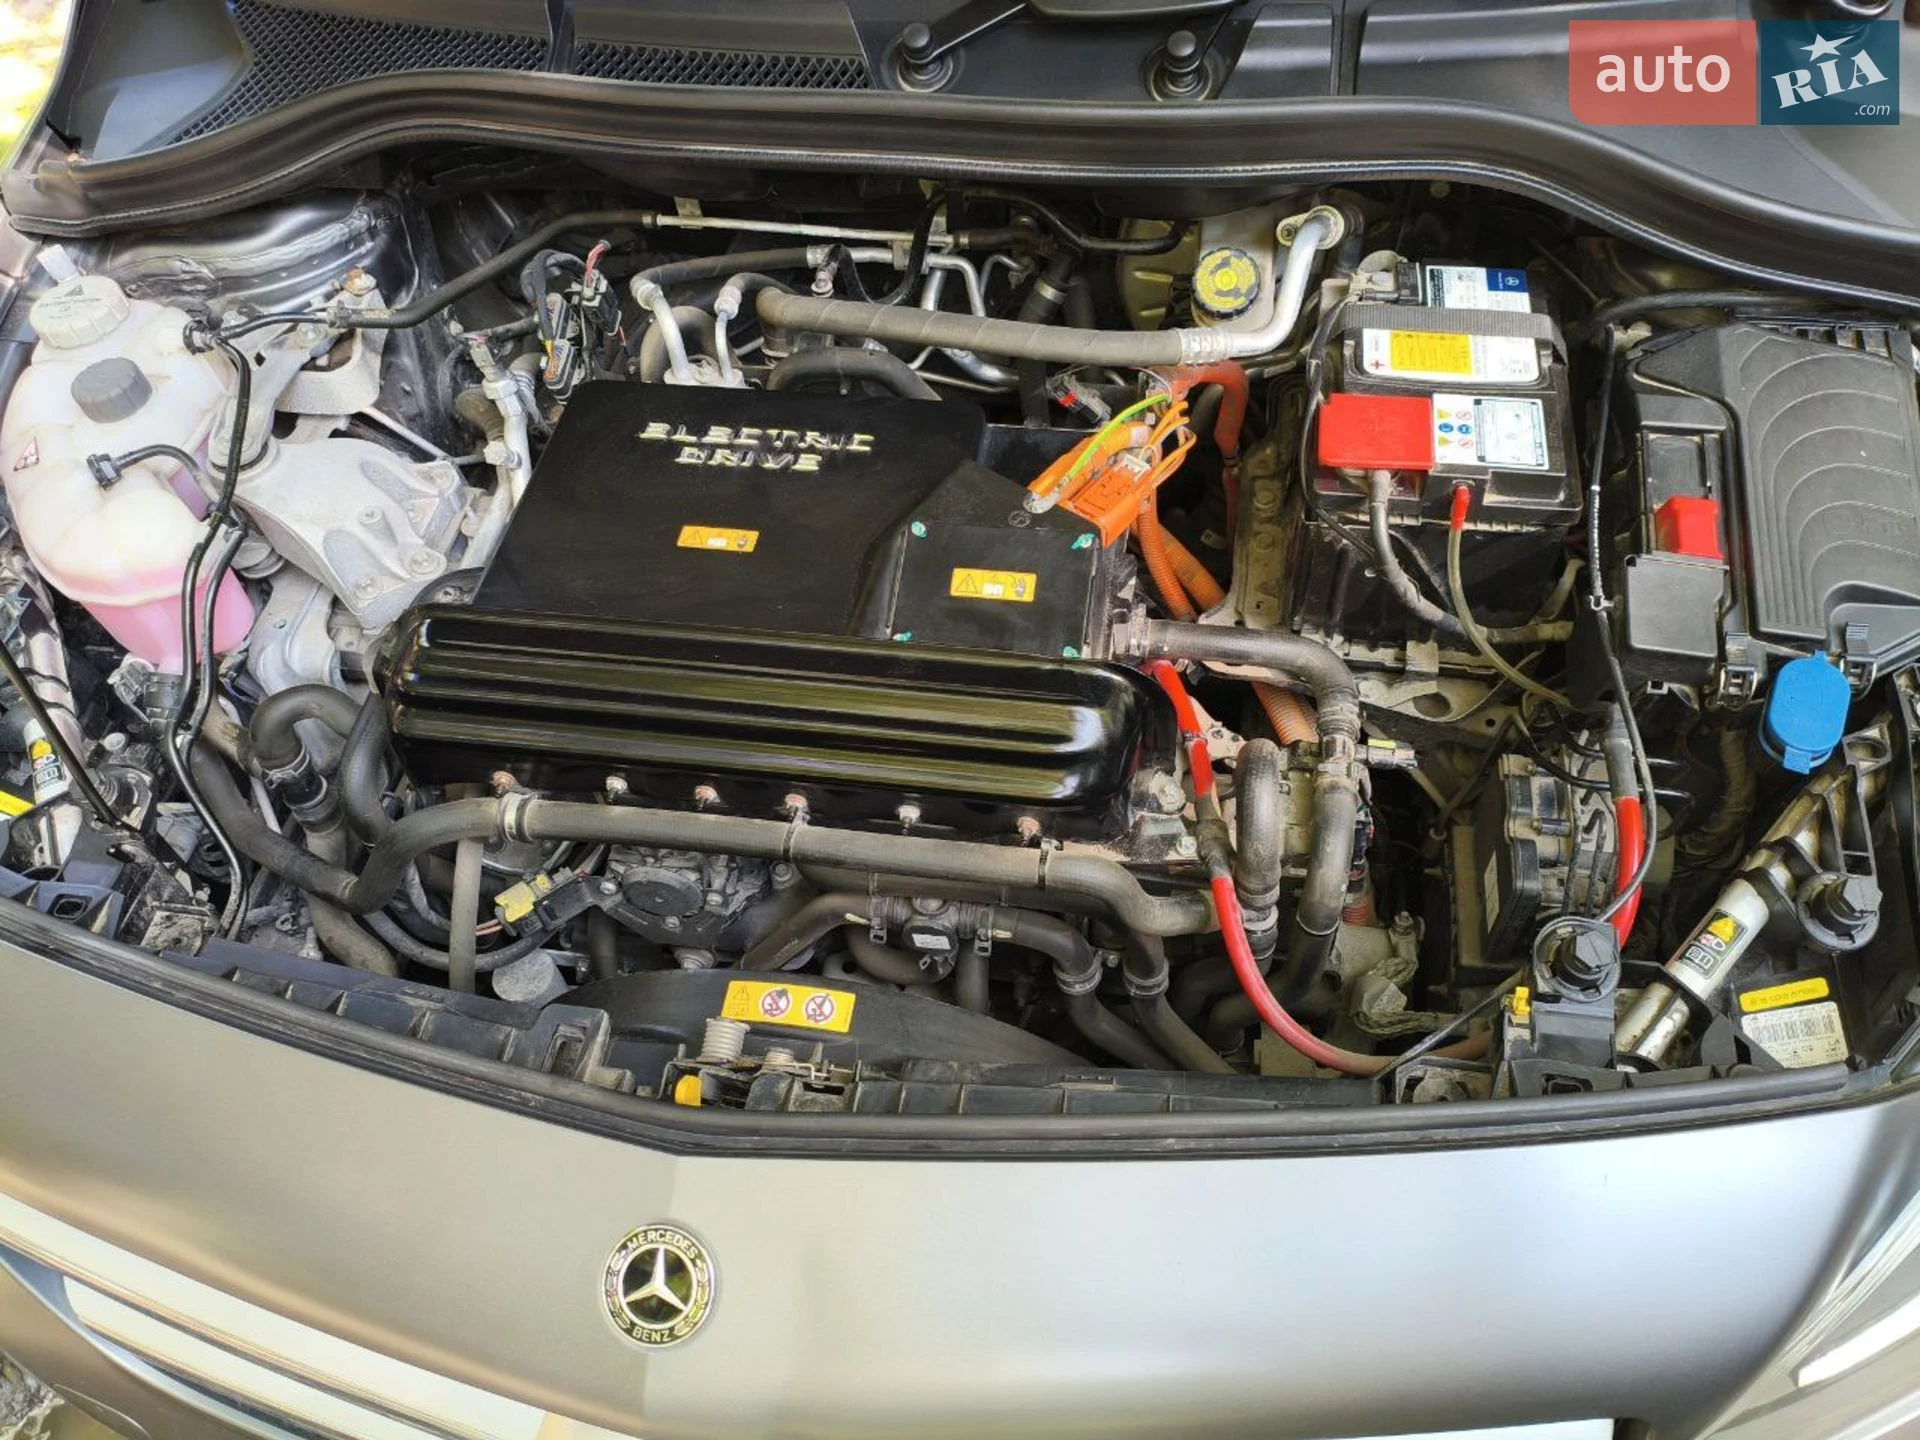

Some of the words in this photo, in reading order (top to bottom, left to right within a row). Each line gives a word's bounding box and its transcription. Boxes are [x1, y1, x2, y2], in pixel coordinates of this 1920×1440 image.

[636, 422, 875, 451] ELECTRIC
[674, 446, 823, 472] DRIVE
[627, 1230, 698, 1259] MERCEDES
[632, 1327, 671, 1342] BENZ
